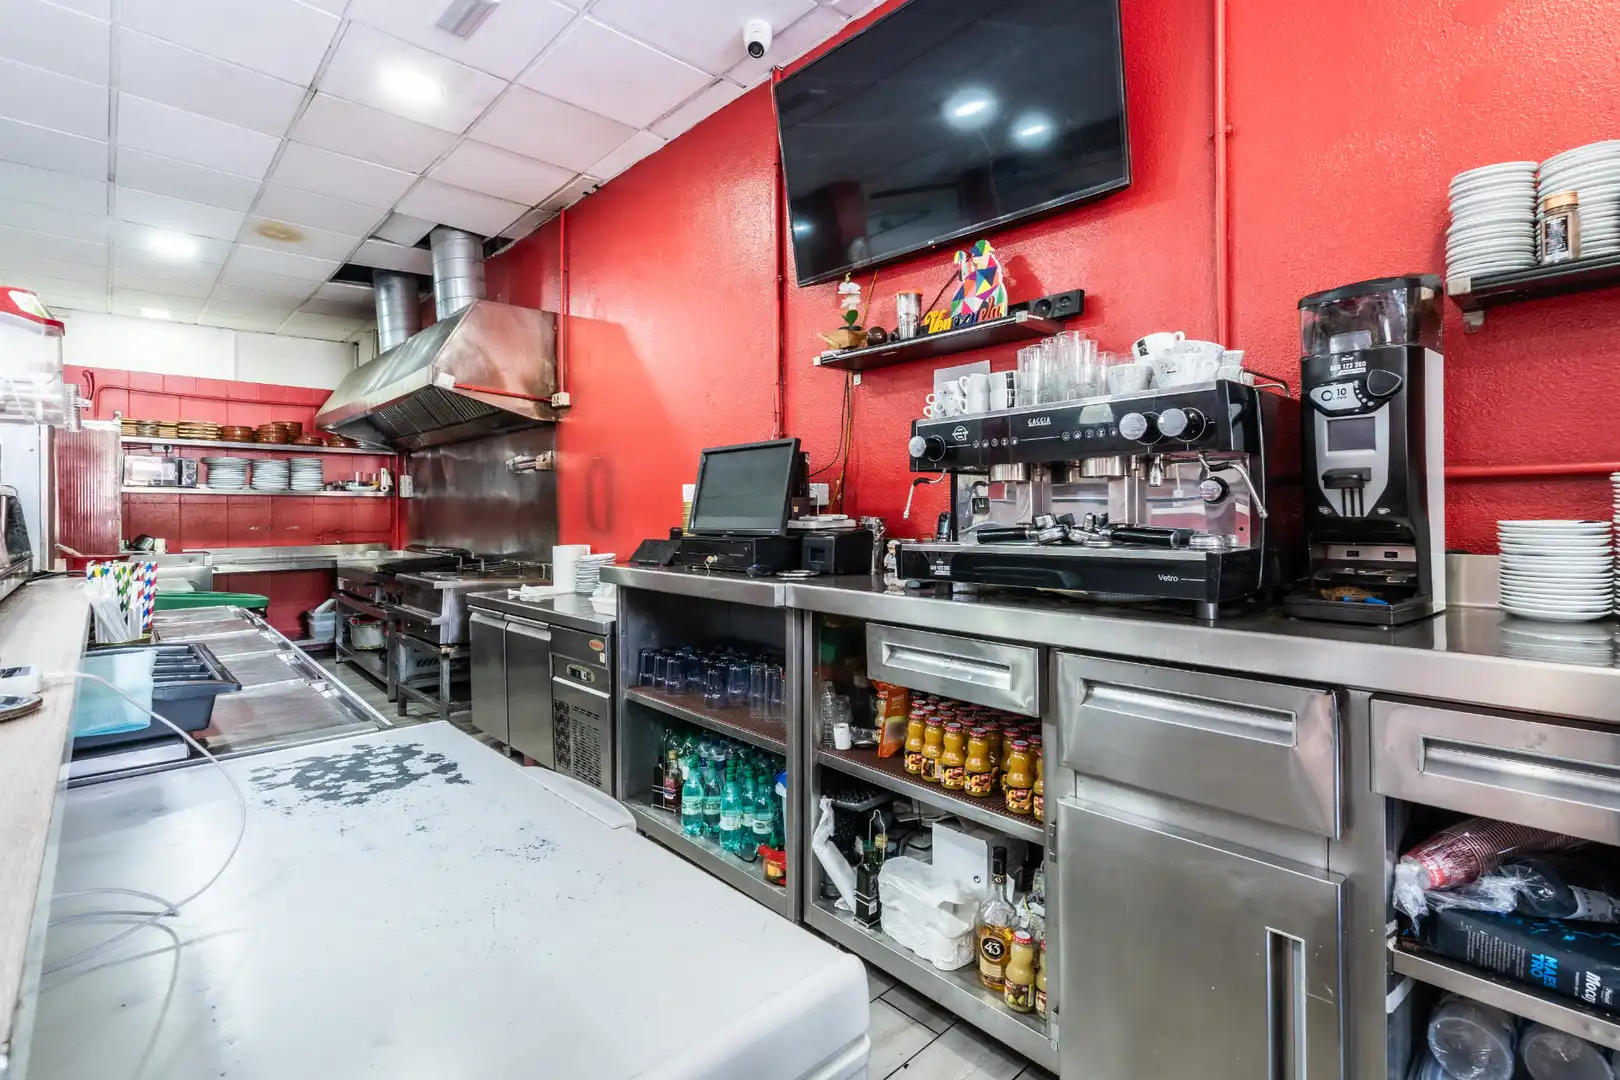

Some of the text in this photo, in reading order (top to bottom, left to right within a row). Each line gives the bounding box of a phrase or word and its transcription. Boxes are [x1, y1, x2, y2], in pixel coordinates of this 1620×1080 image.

[924, 296, 1002, 334] Venezuela
[1027, 416, 1051, 427] GAGGIA
[1158, 574, 1178, 582] Vetro
[984, 941, 1002, 956] 43
